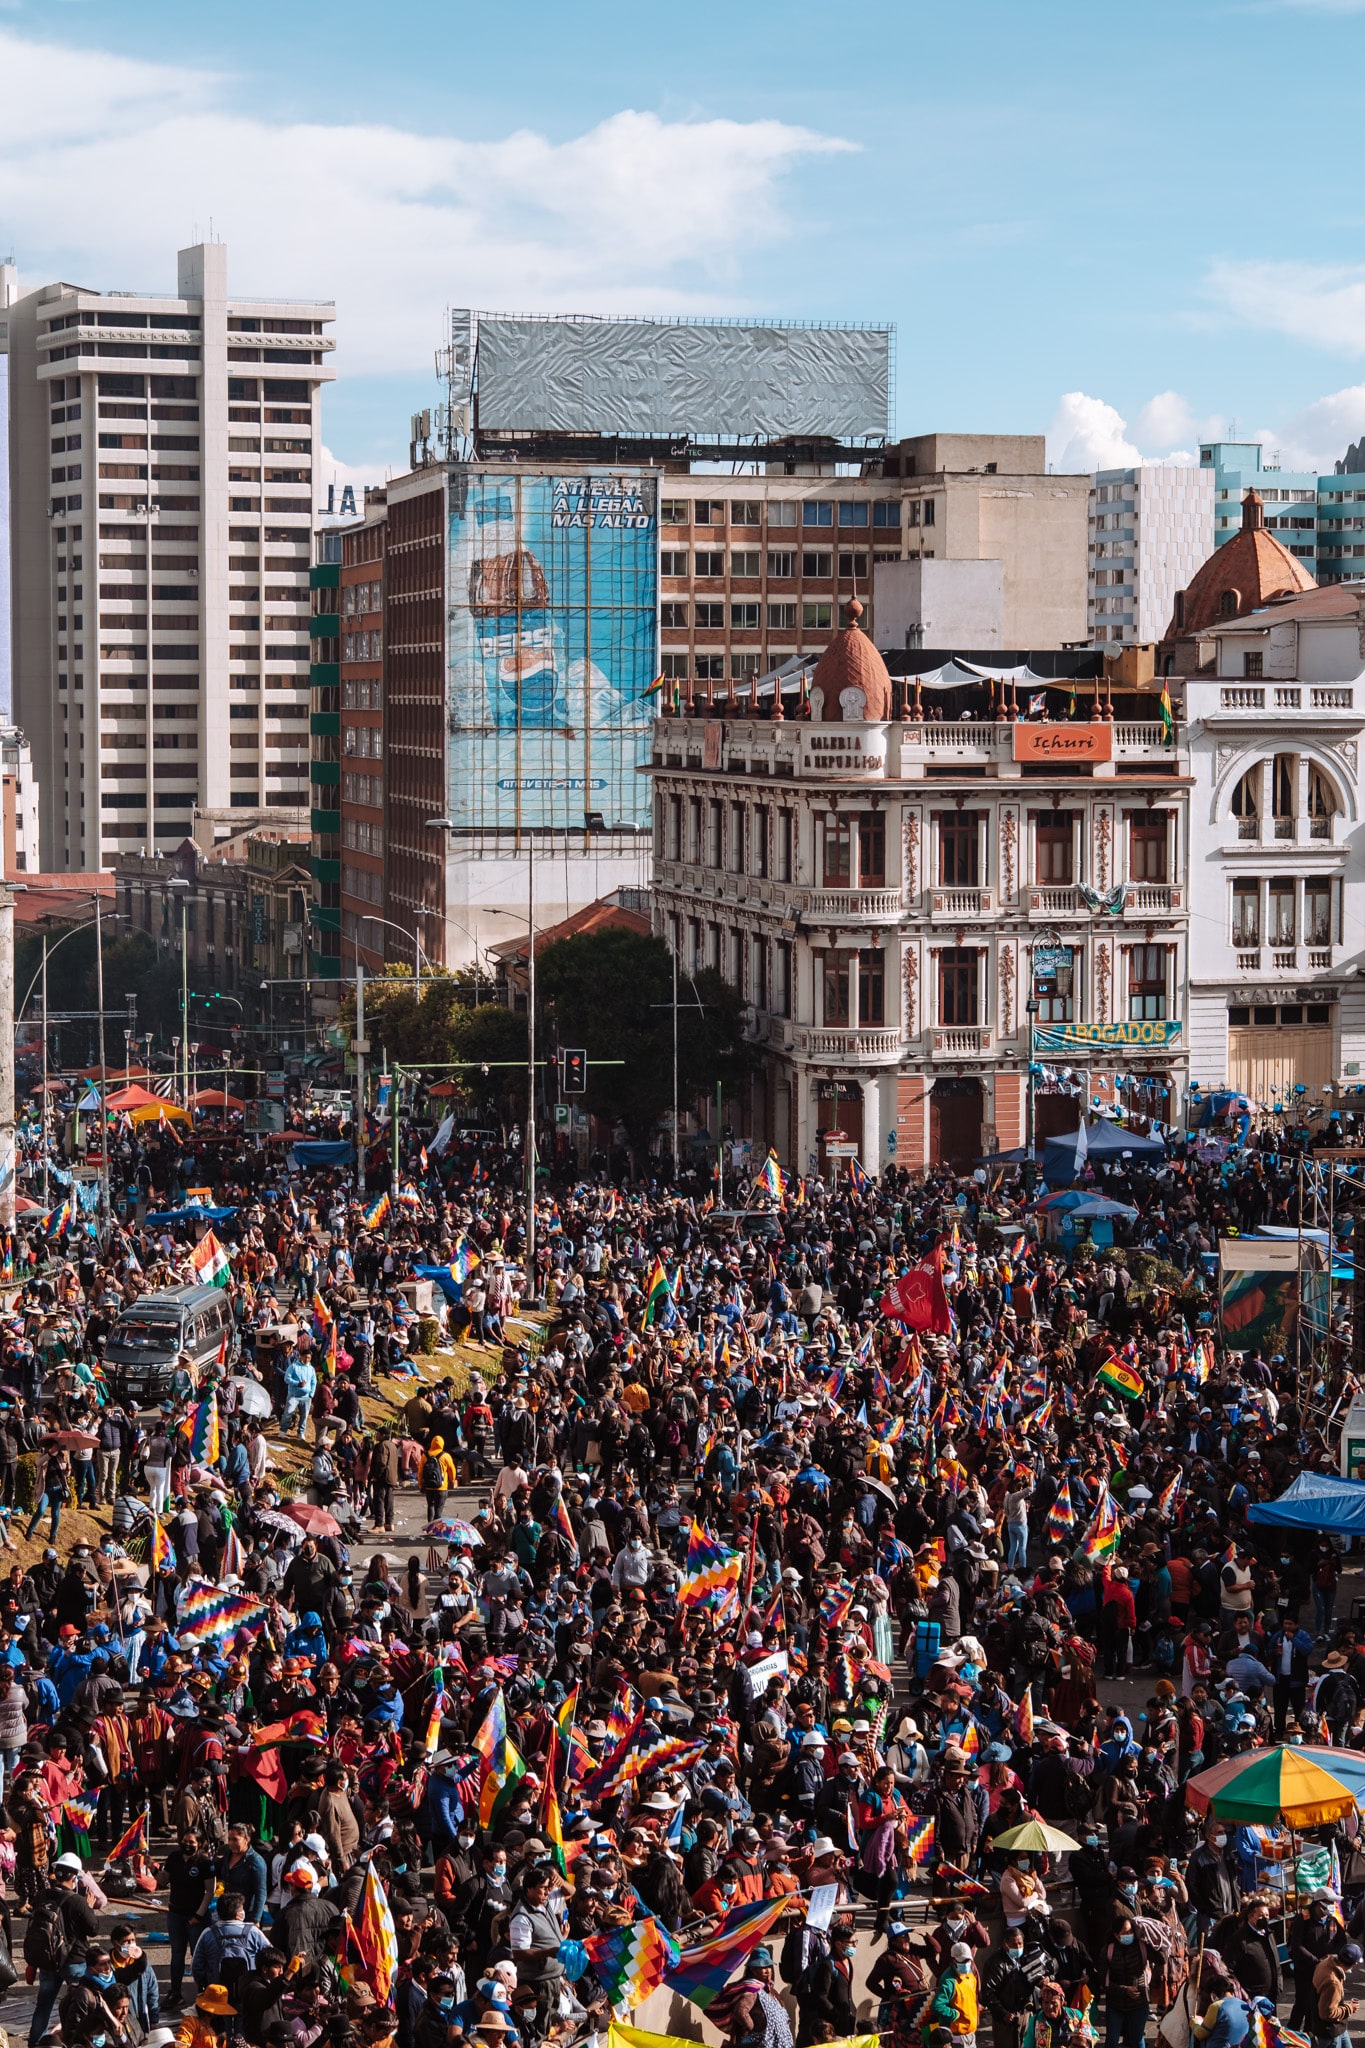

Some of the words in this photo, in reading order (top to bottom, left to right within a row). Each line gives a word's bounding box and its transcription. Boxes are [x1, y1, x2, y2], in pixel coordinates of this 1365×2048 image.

[554, 498, 569, 512] A
[577, 498, 643, 512] LLEGAR
[600, 515, 650, 528] ALTO
[810, 736, 862, 750] GALERIA
[1033, 734, 1094, 748] Ichuri
[814, 755, 883, 769] REPUBLICA
[1233, 986, 1340, 1003] KAUTSCH
[1062, 1023, 1166, 1044] ABOGADOS
[555, 1107, 567, 1121] P
